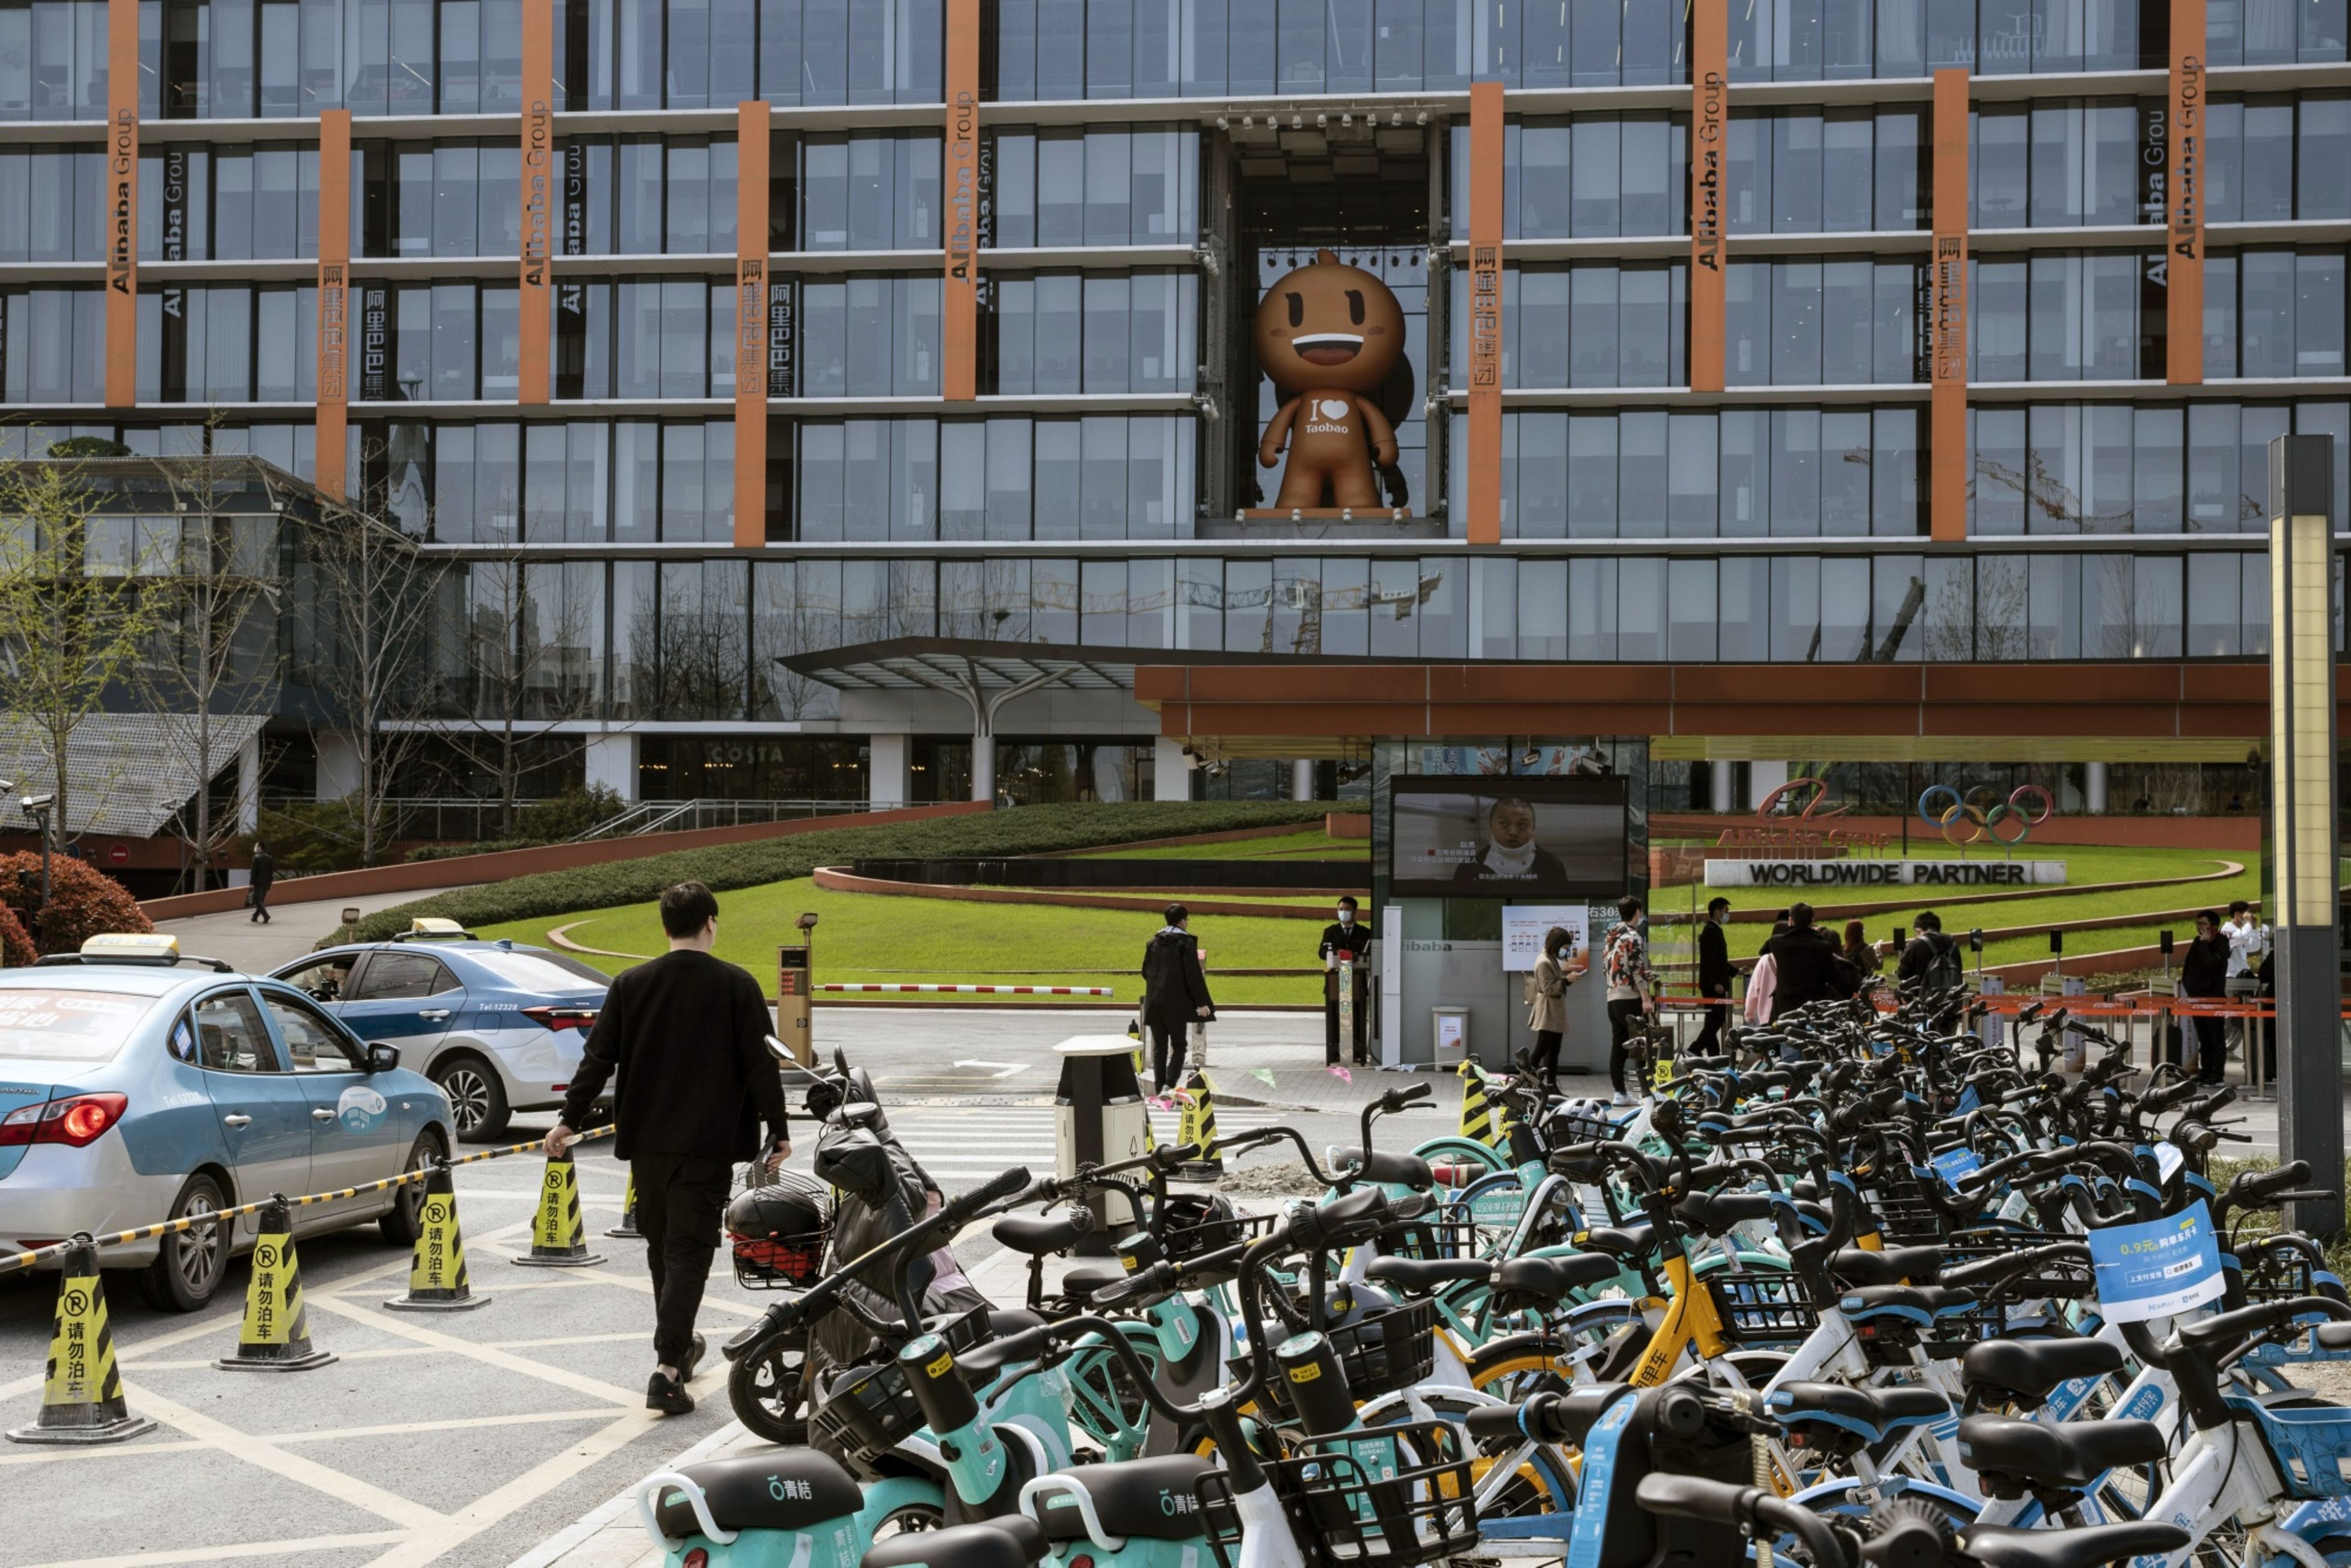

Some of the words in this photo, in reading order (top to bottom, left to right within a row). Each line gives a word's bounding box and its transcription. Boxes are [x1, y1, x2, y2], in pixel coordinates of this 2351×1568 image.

[952, 91, 976, 158] Group
[1699, 72, 1725, 143] Group
[2176, 56, 2203, 129] Group
[113, 108, 135, 175] Group
[527, 100, 550, 168] Group
[2144, 111, 2165, 165] Grou
[165, 152, 183, 203] Grou
[569, 145, 581, 197] Grou
[2175, 136, 2198, 260] Alibaba
[112, 182, 130, 295] Alibaba
[526, 174, 546, 287] Alibaba
[951, 167, 972, 284] Alibaba
[1699, 151, 1719, 272] Alibaba
[322, 266, 343, 397] 阿里巴巴集团
[741, 259, 763, 394] 阿里巴巴集团
[770, 284, 791, 397] 阿里巴巴集
[1475, 247, 1497, 385] 阿里巴巴集团
[1938, 237, 1962, 379] 阿里巴巴集团
[365, 290, 386, 401] 阿里巴巴集
[1305, 423, 1349, 434] Taobao
[1310, 399, 1319, 421] I
[711, 747, 783, 764] COSTA
[1717, 829, 1823, 847] Alibaba
[1828, 828, 1890, 851] Group
[1749, 863, 1900, 884] WORLDWIDE
[1913, 864, 2026, 884] PARTNER
[1185, 1113, 1195, 1143] 请勿泊
[545, 1192, 560, 1244] 请勿泊车
[428, 1227, 444, 1285] 请勿泊车
[257, 1272, 274, 1340] 请勿泊车
[66, 1321, 85, 1399] 请勿泊车
[2133, 1389, 2156, 1416] 支付宝
[783, 1479, 812, 1499] 青桔
